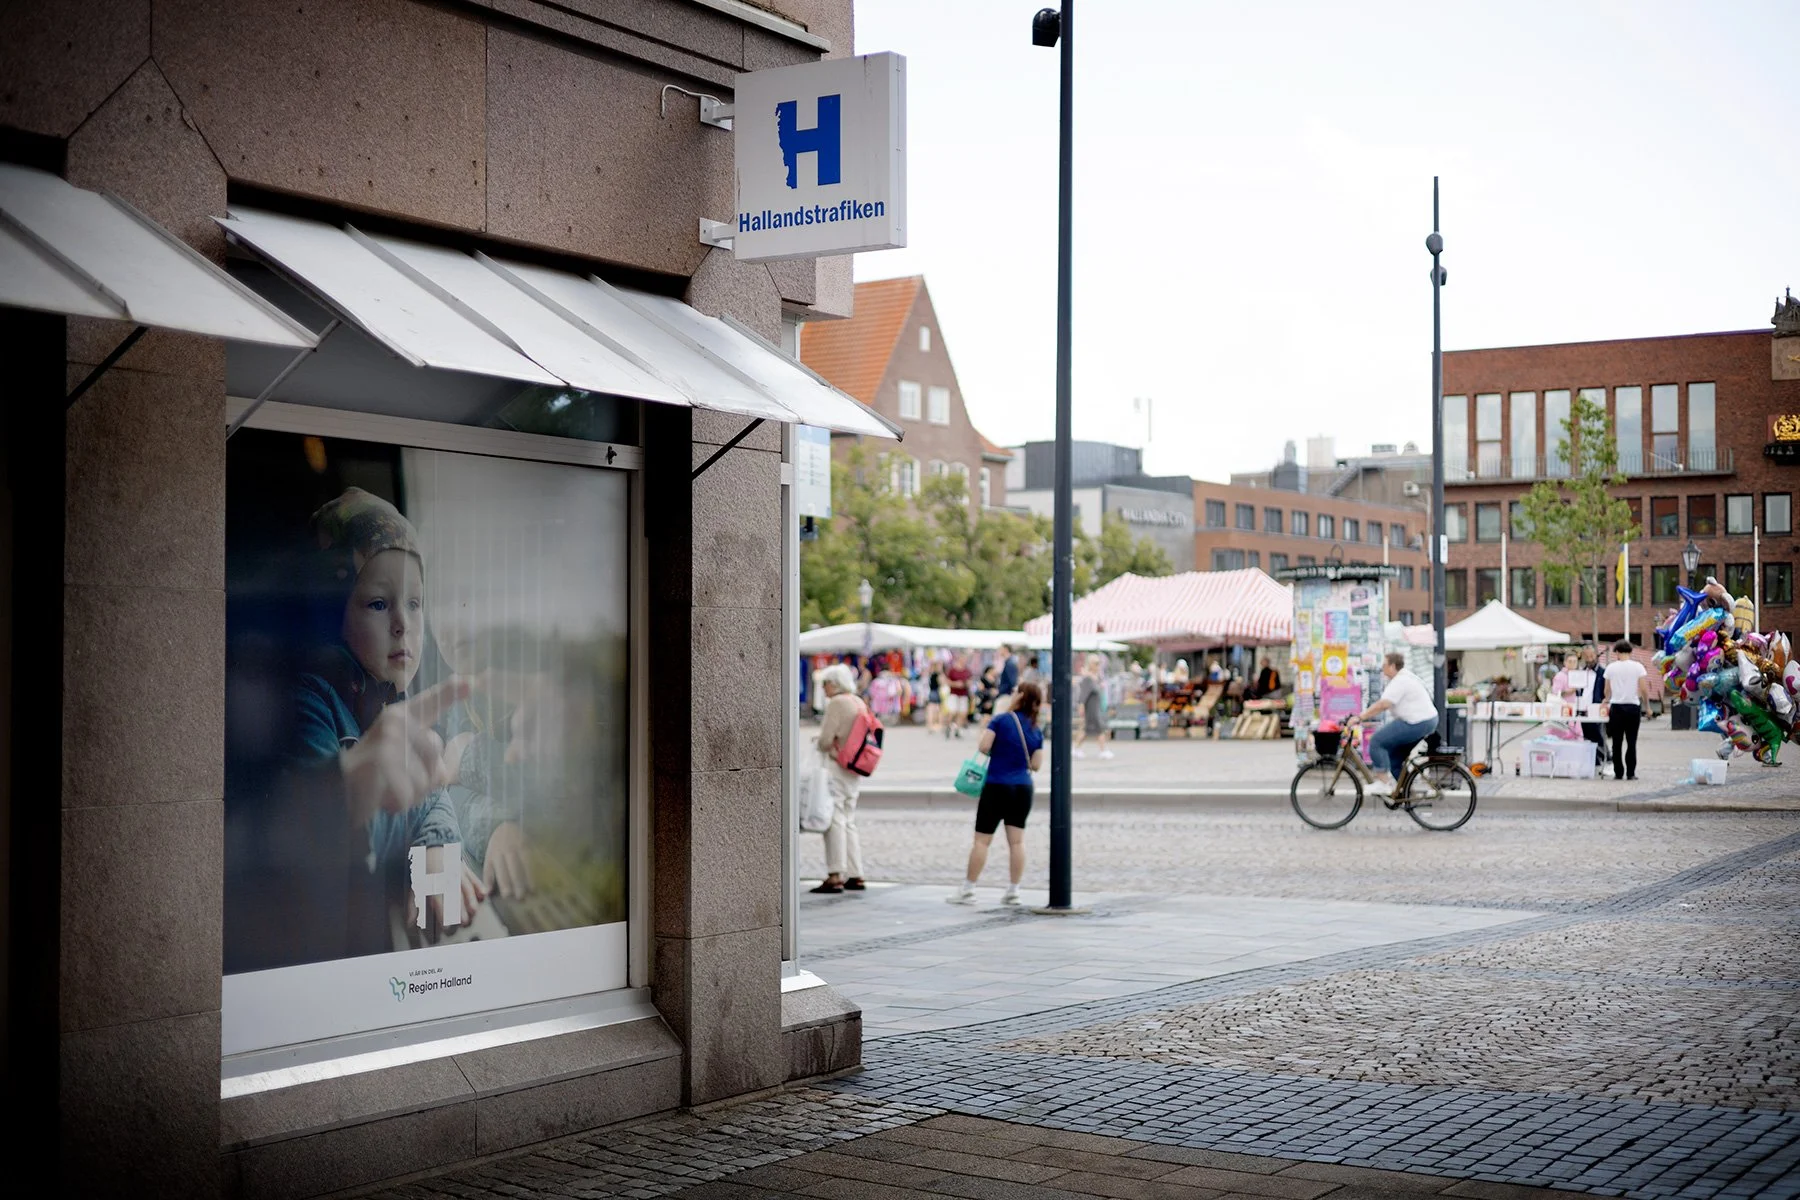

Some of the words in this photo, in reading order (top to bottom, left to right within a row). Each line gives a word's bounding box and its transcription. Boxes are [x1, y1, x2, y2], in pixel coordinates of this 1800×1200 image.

[775, 94, 841, 189] H
[739, 200, 885, 232] Hallandstrafiken
[408, 842, 462, 930] H
[408, 980, 439, 995] Region
[440, 974, 472, 989] Halland
